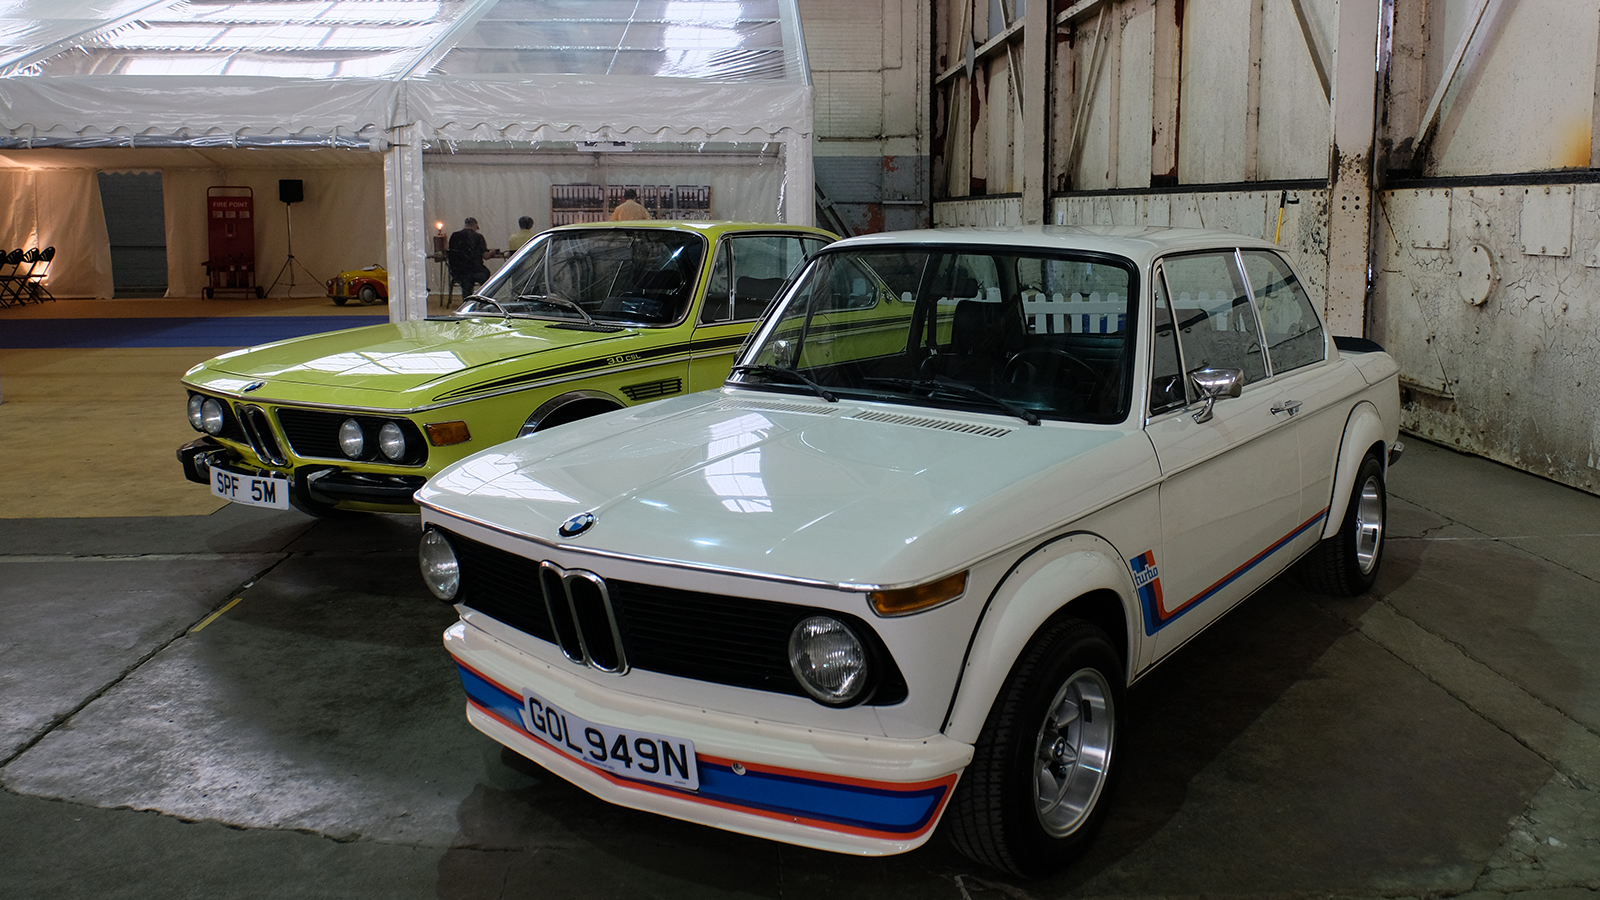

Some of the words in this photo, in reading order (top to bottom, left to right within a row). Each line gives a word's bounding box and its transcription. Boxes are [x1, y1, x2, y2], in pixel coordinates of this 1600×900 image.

[217, 472, 239, 497] SPF
[251, 480, 276, 503] 5M
[1134, 566, 1159, 586] turbo
